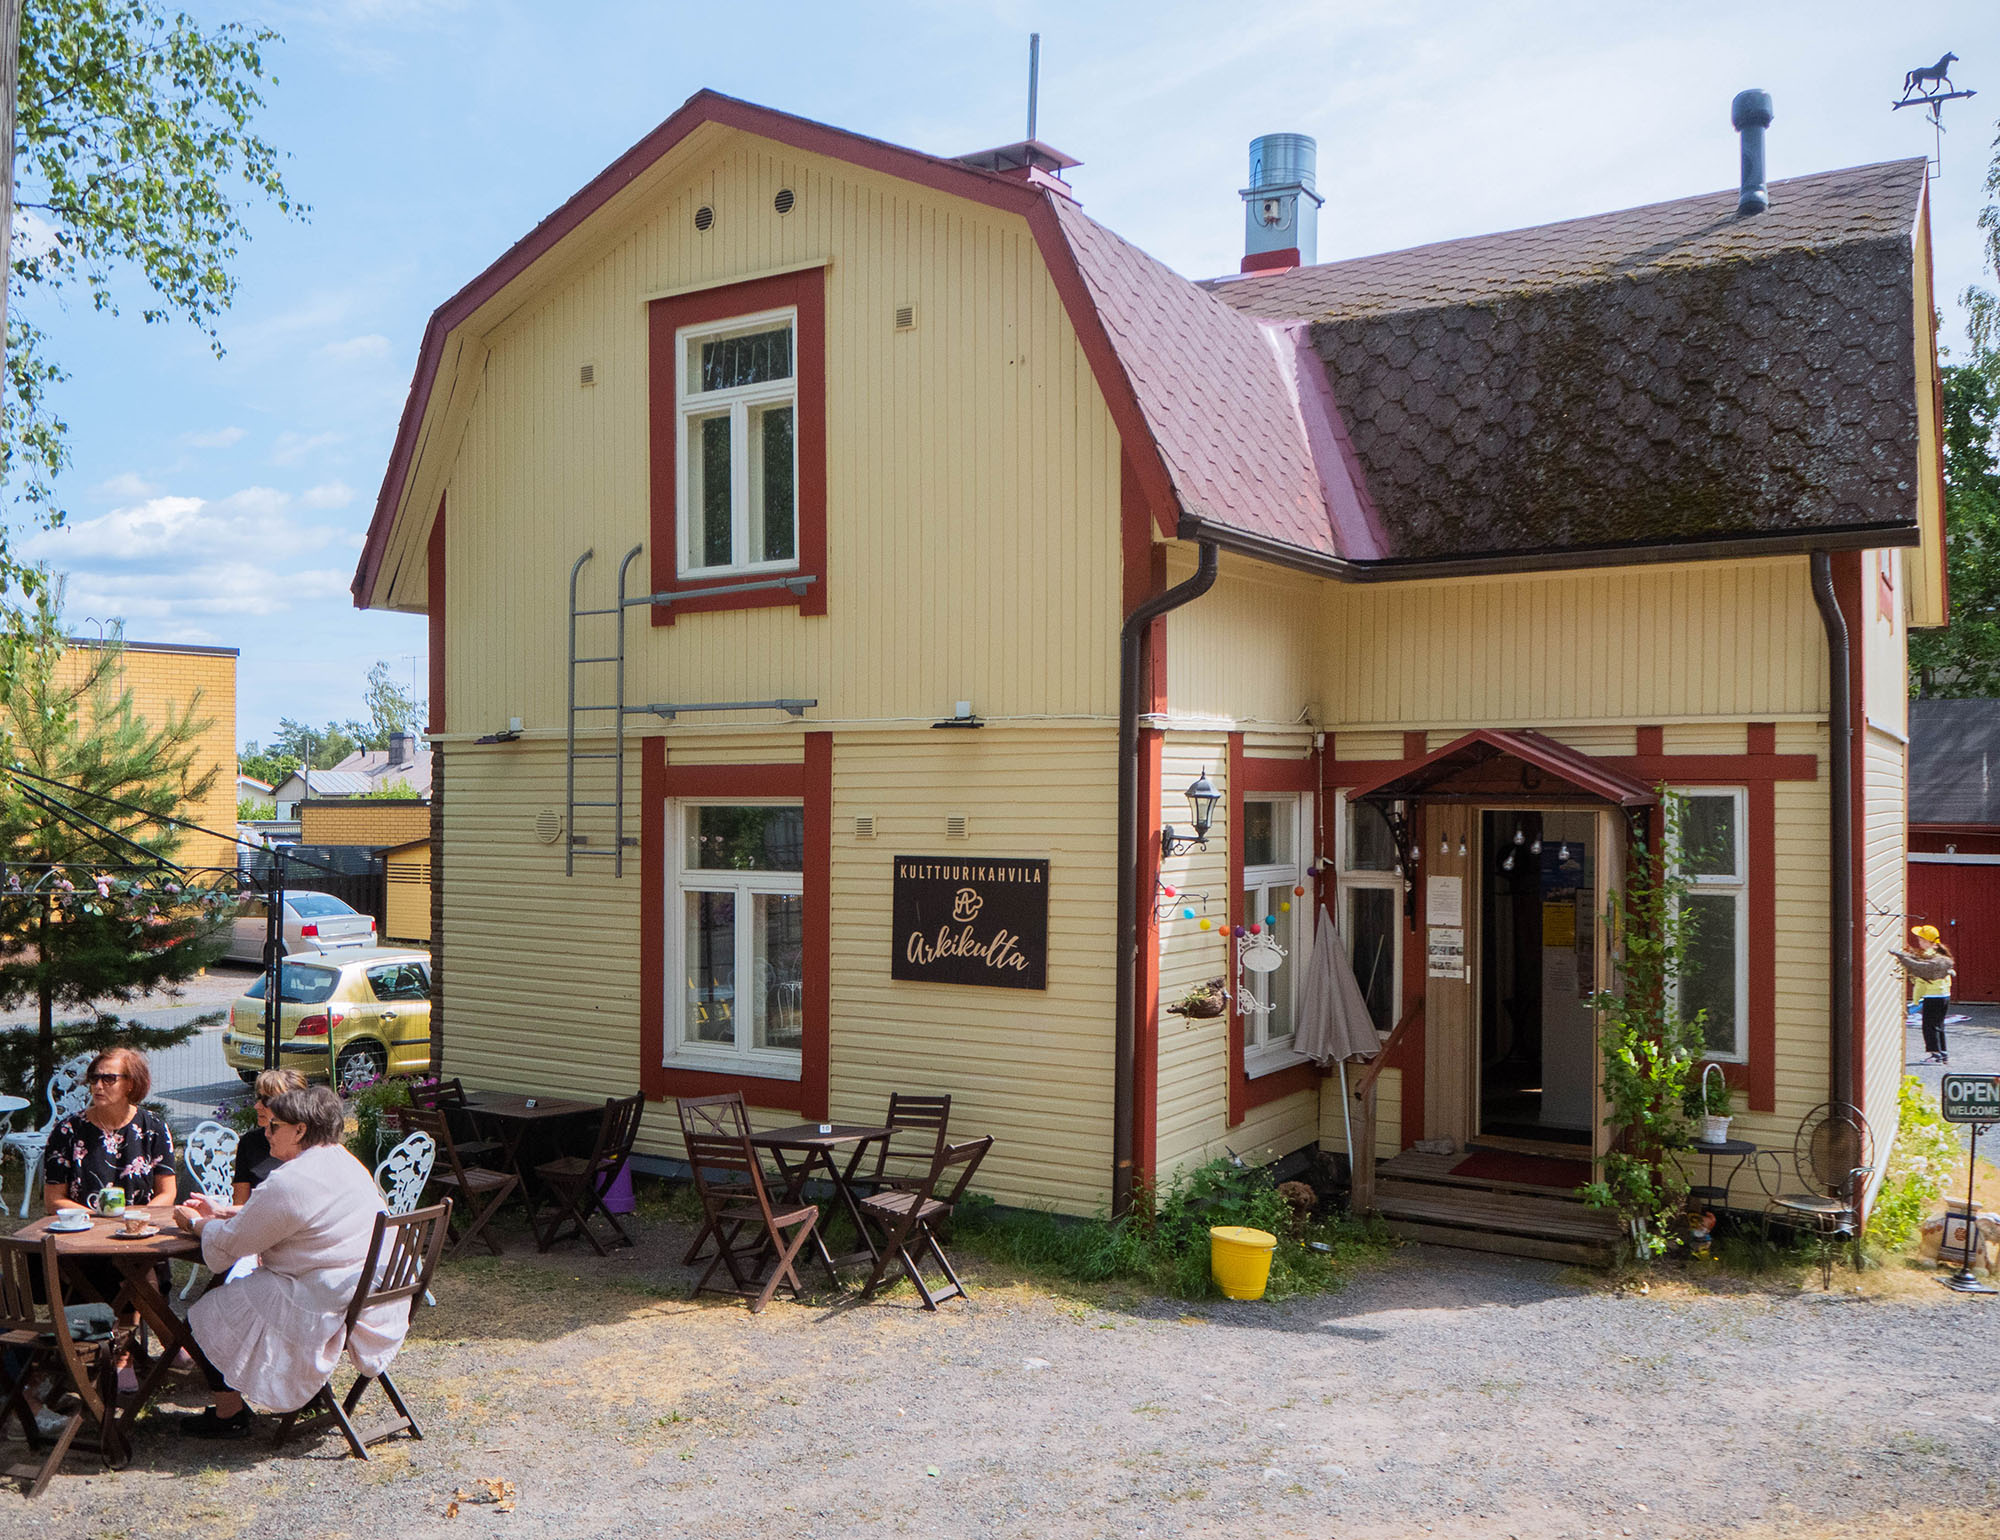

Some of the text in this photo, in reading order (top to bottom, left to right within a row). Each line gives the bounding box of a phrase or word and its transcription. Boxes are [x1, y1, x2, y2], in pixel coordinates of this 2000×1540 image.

[900, 864, 1041, 883] KULTTUURIKAHVILA
[906, 925, 1030, 971] Arkikulta
[1948, 1081, 2000, 1102] OPEN
[1948, 1105, 2000, 1116] WELCOME
